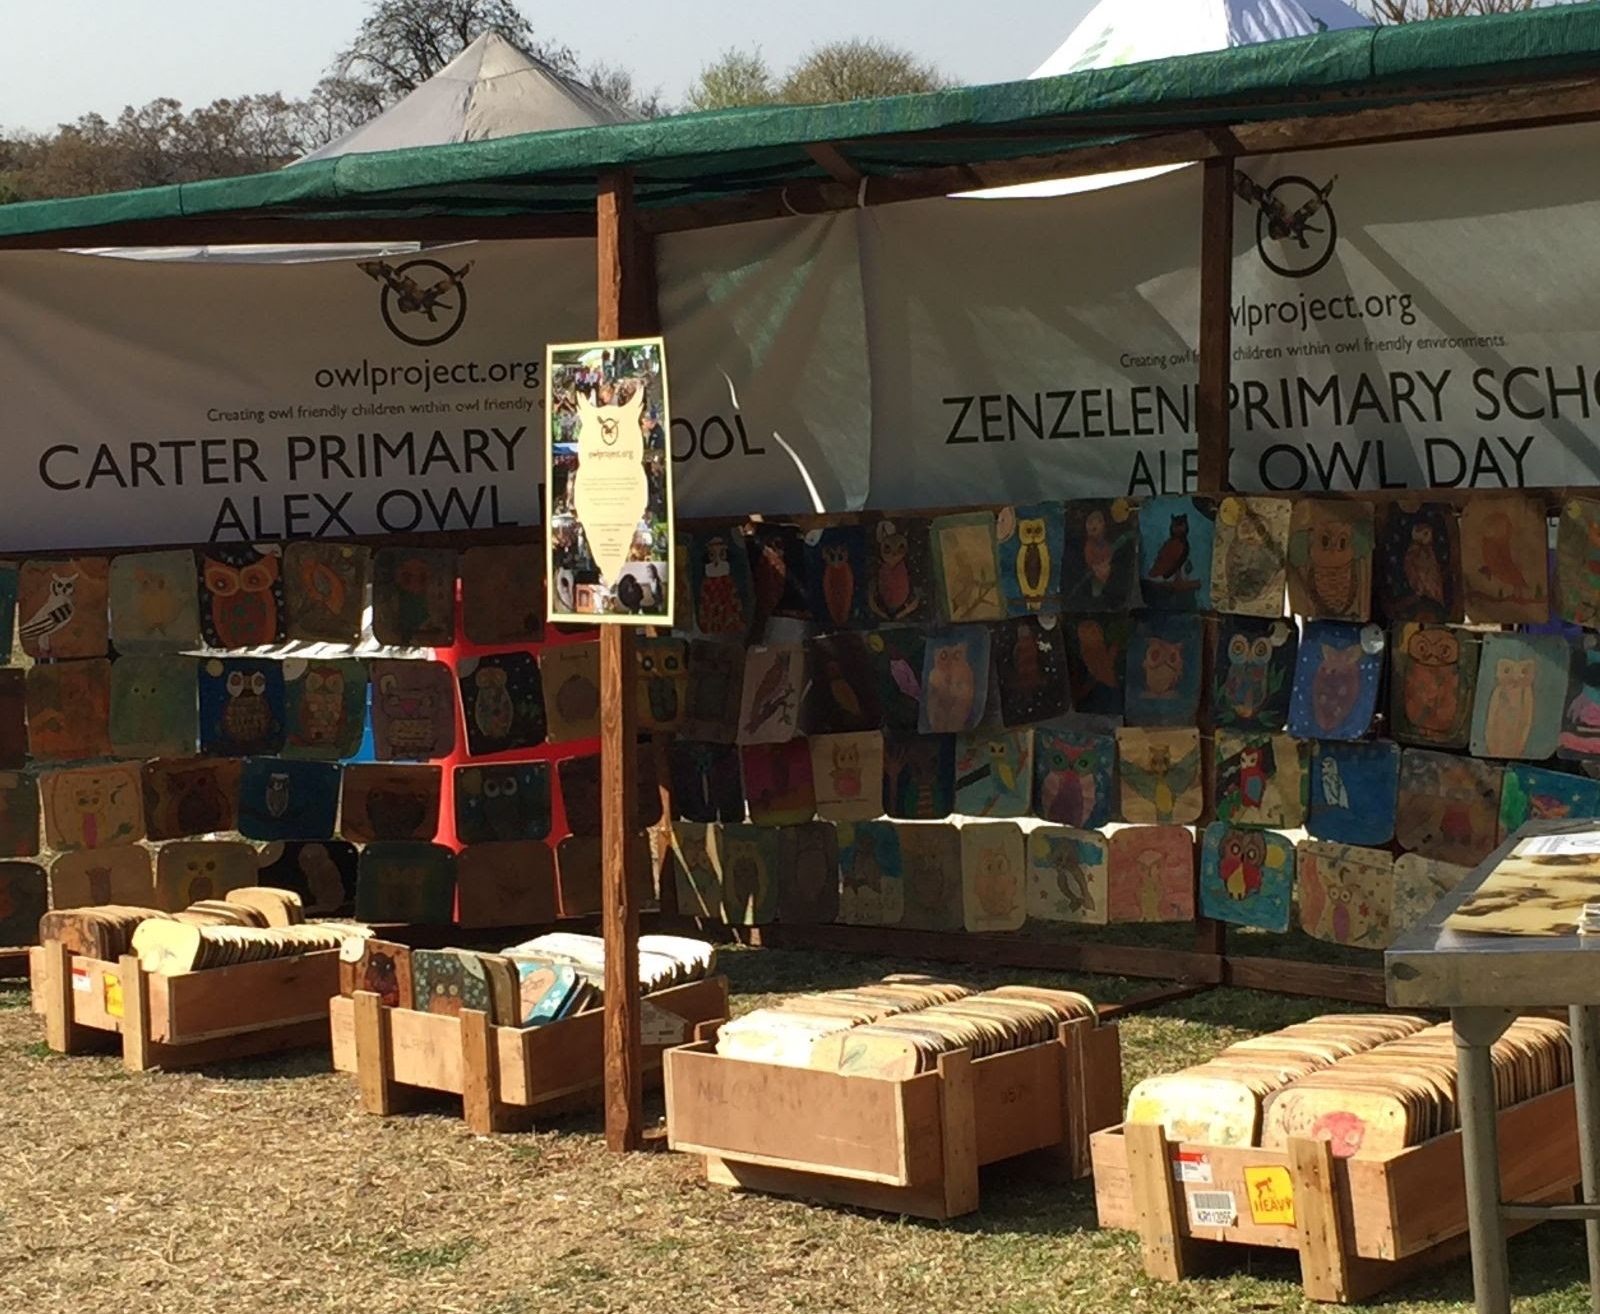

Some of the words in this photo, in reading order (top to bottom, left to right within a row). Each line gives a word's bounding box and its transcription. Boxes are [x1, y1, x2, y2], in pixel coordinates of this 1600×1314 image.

[1230, 293, 1416, 336] lproject.org
[1119, 353, 1167, 370] Creating
[1170, 351, 1191, 365] owl
[1233, 347, 1282, 361] children
[1288, 342, 1330, 357] within
[1335, 338, 1360, 353] owl
[1364, 336, 1413, 354] friendly
[315, 359, 540, 394] owlproject.org
[1473, 365, 1600, 421] SCH
[207, 408, 265, 424] Creating
[269, 407, 293, 420] owl
[297, 405, 347, 421] friendly
[352, 403, 405, 417] children
[410, 401, 450, 414] within
[455, 399, 480, 412] owl
[484, 398, 533, 413] friendly
[943, 383, 1200, 444] ZENZELENI
[39, 437, 268, 490] CARTER
[286, 426, 527, 481] PRIMARY
[1128, 447, 1237, 497] ALE
[1259, 440, 1407, 491] OWL
[1424, 435, 1535, 489] DAY
[209, 490, 357, 543] ALEX
[376, 484, 519, 533] OWL
[1254, 1197, 1292, 1212] HEAVY
